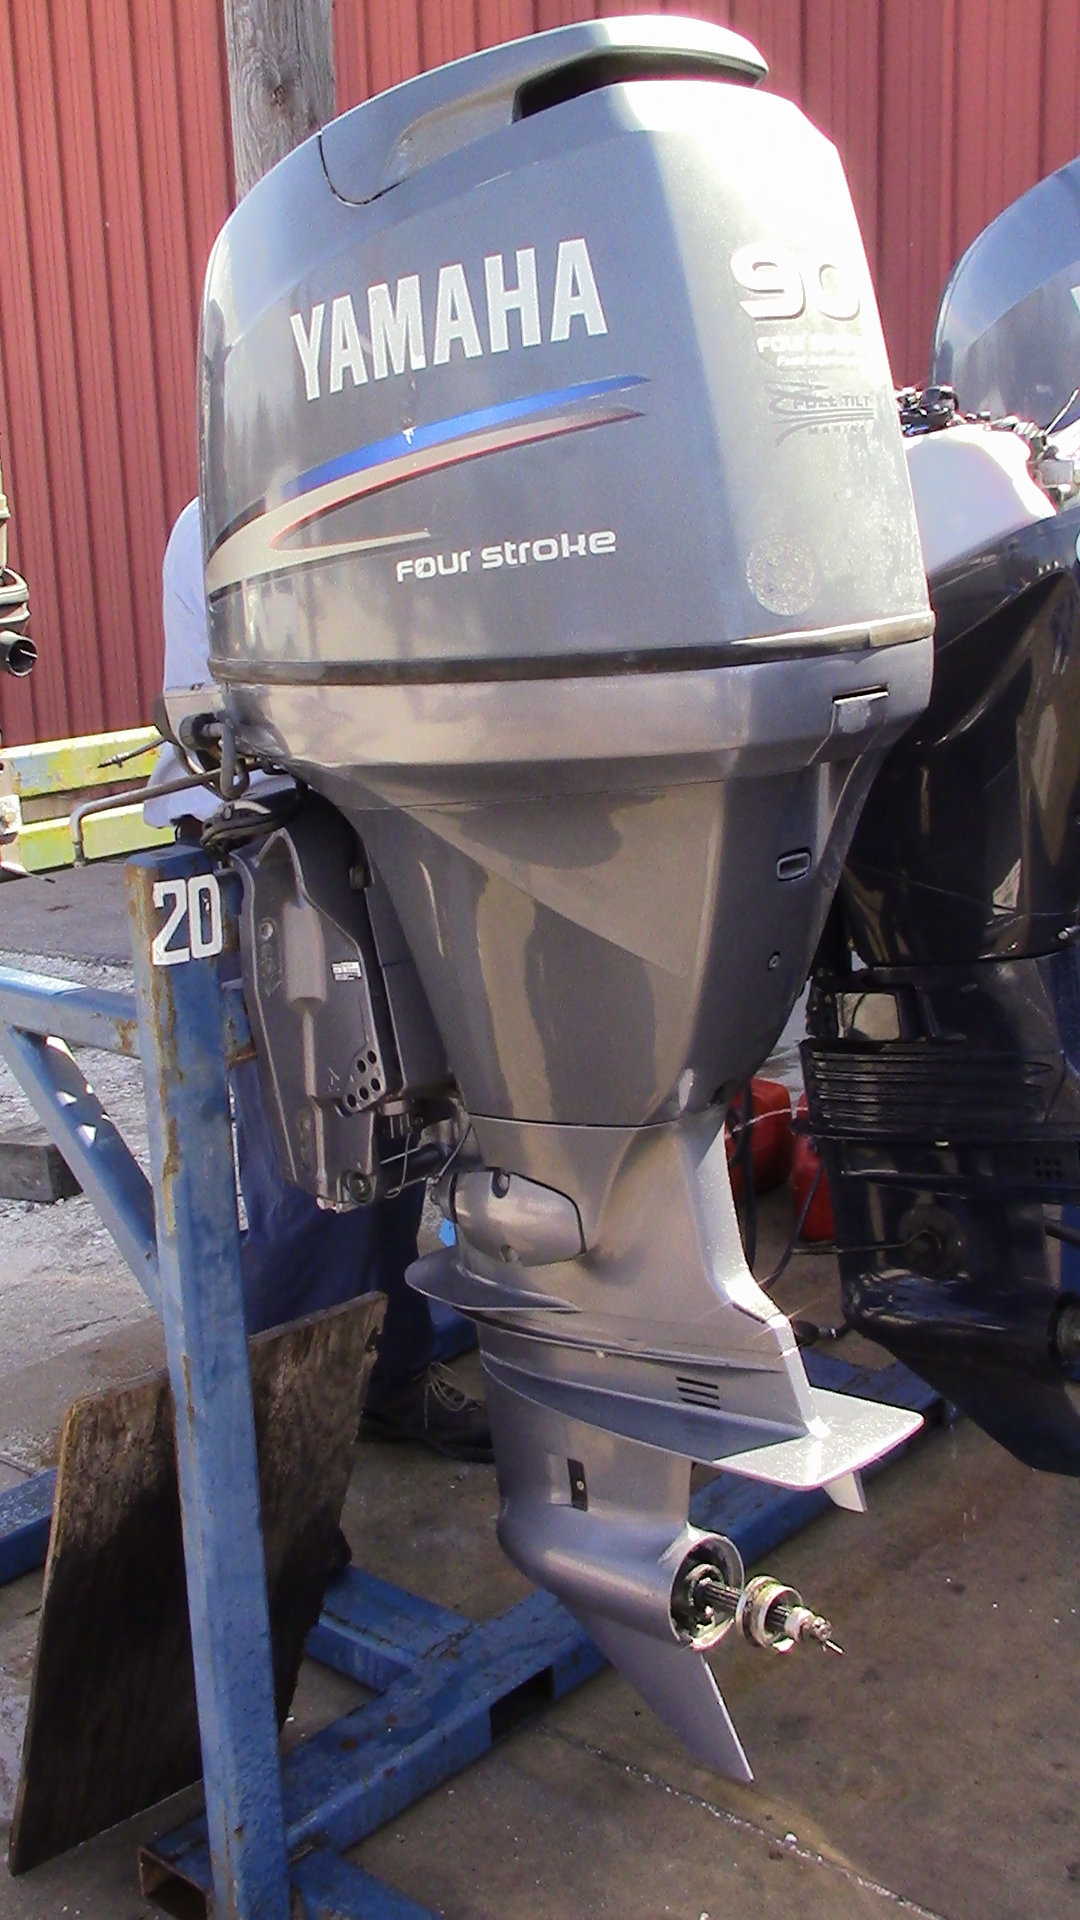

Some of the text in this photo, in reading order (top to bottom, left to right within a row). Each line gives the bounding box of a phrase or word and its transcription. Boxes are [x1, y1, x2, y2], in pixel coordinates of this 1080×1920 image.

[290, 237, 608, 401] YAMAHA
[729, 243, 862, 322] 90
[842, 395, 870, 408] TILT
[151, 873, 223, 966] 20
